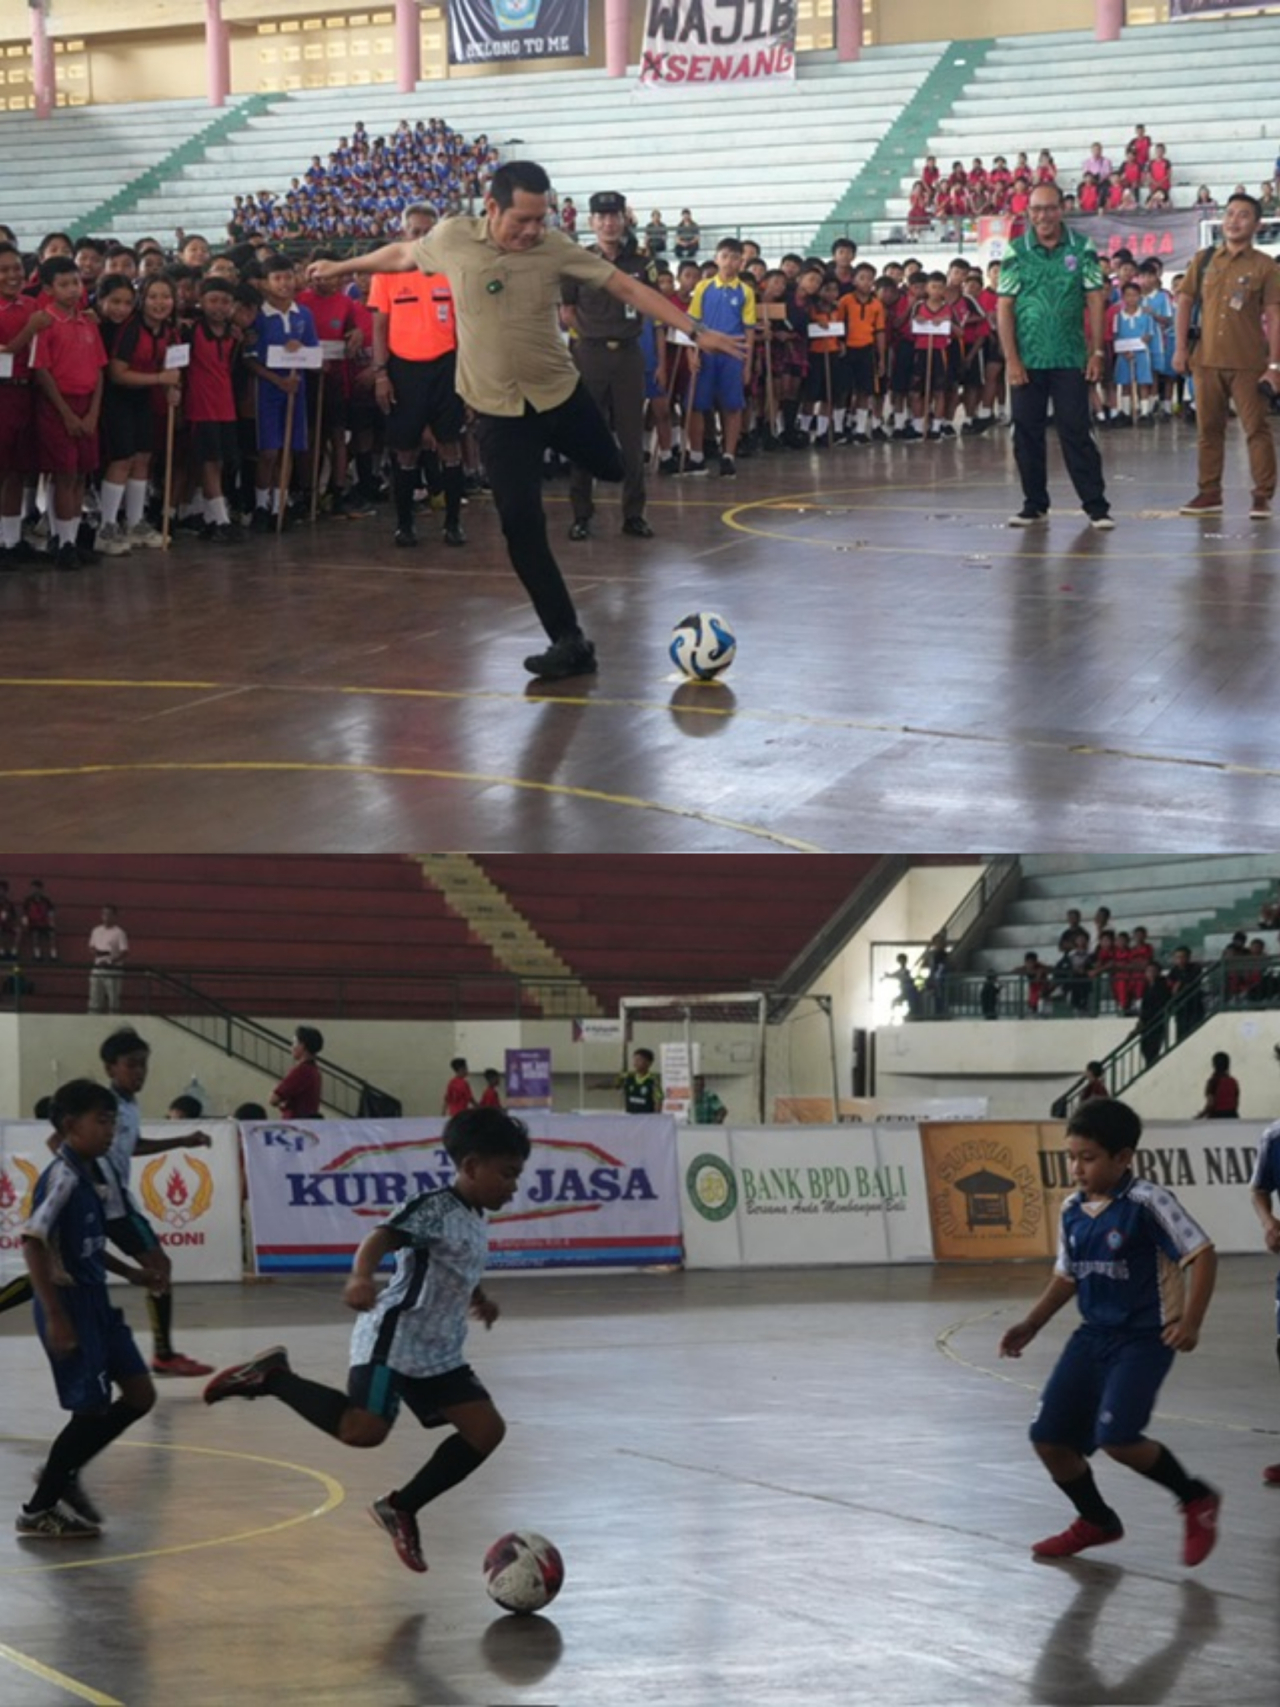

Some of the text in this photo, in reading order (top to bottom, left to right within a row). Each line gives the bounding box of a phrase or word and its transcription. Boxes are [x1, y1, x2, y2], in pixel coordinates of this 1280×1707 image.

[523, 37, 544, 53] TO
[547, 35, 569, 52] ME
[527, 1167, 659, 1202] JASA
[741, 1164, 907, 1201] BANK BPD BALI
[159, 1231, 205, 1247] KONI
